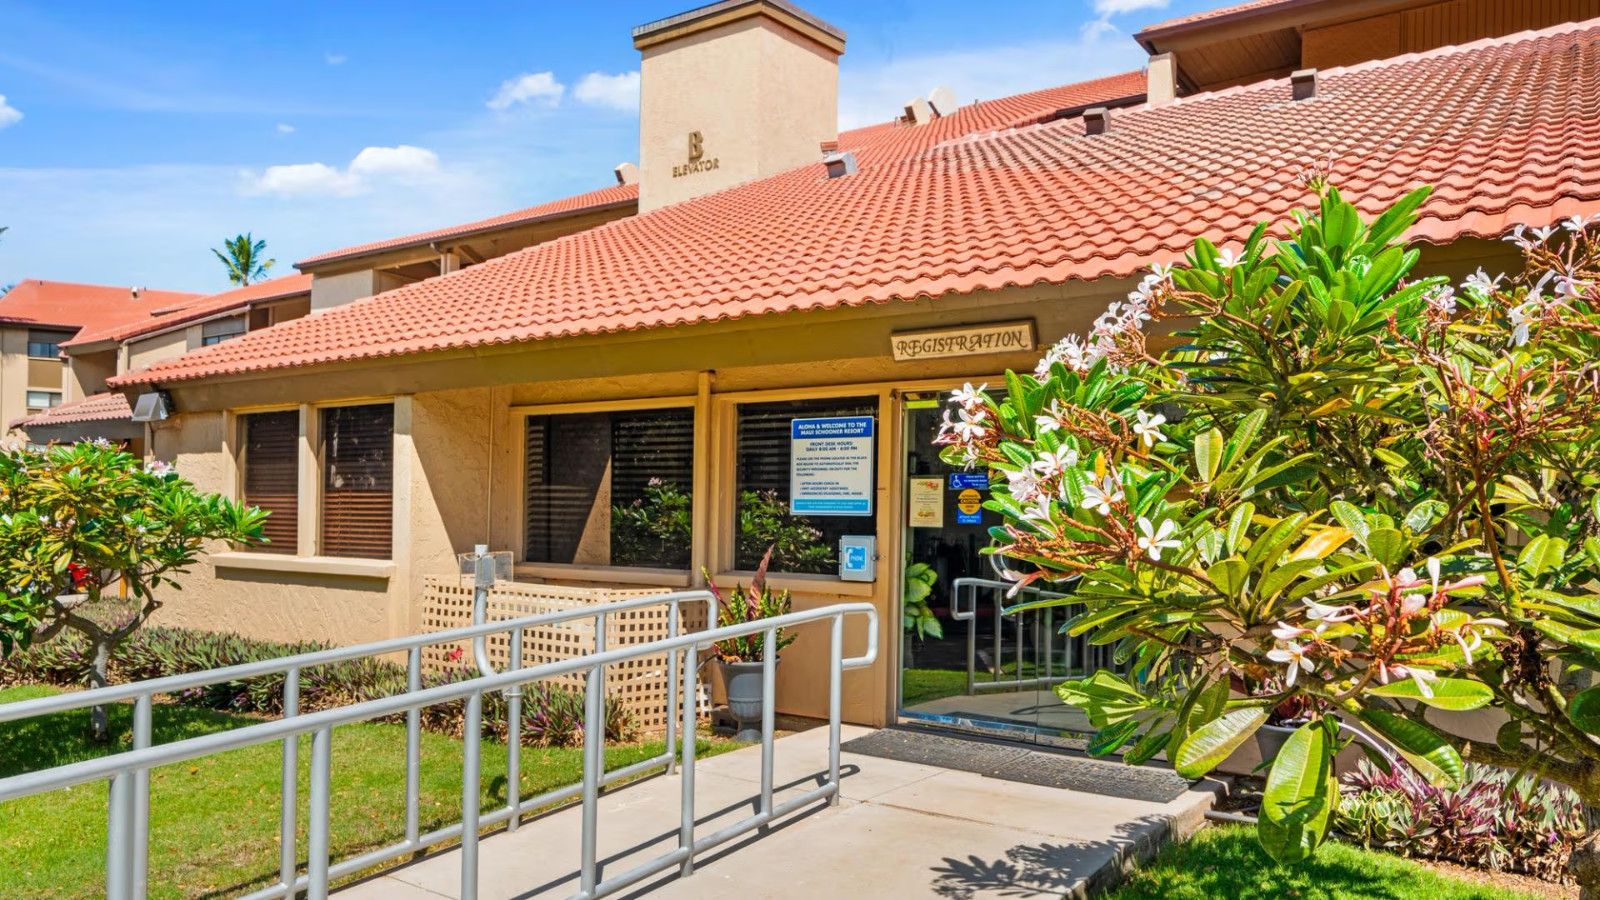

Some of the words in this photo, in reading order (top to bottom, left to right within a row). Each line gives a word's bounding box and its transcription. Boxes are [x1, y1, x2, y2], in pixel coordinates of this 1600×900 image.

[688, 130, 704, 163] B
[672, 158, 720, 178] ELEVATOR
[896, 330, 1028, 357] REGISTRATION
